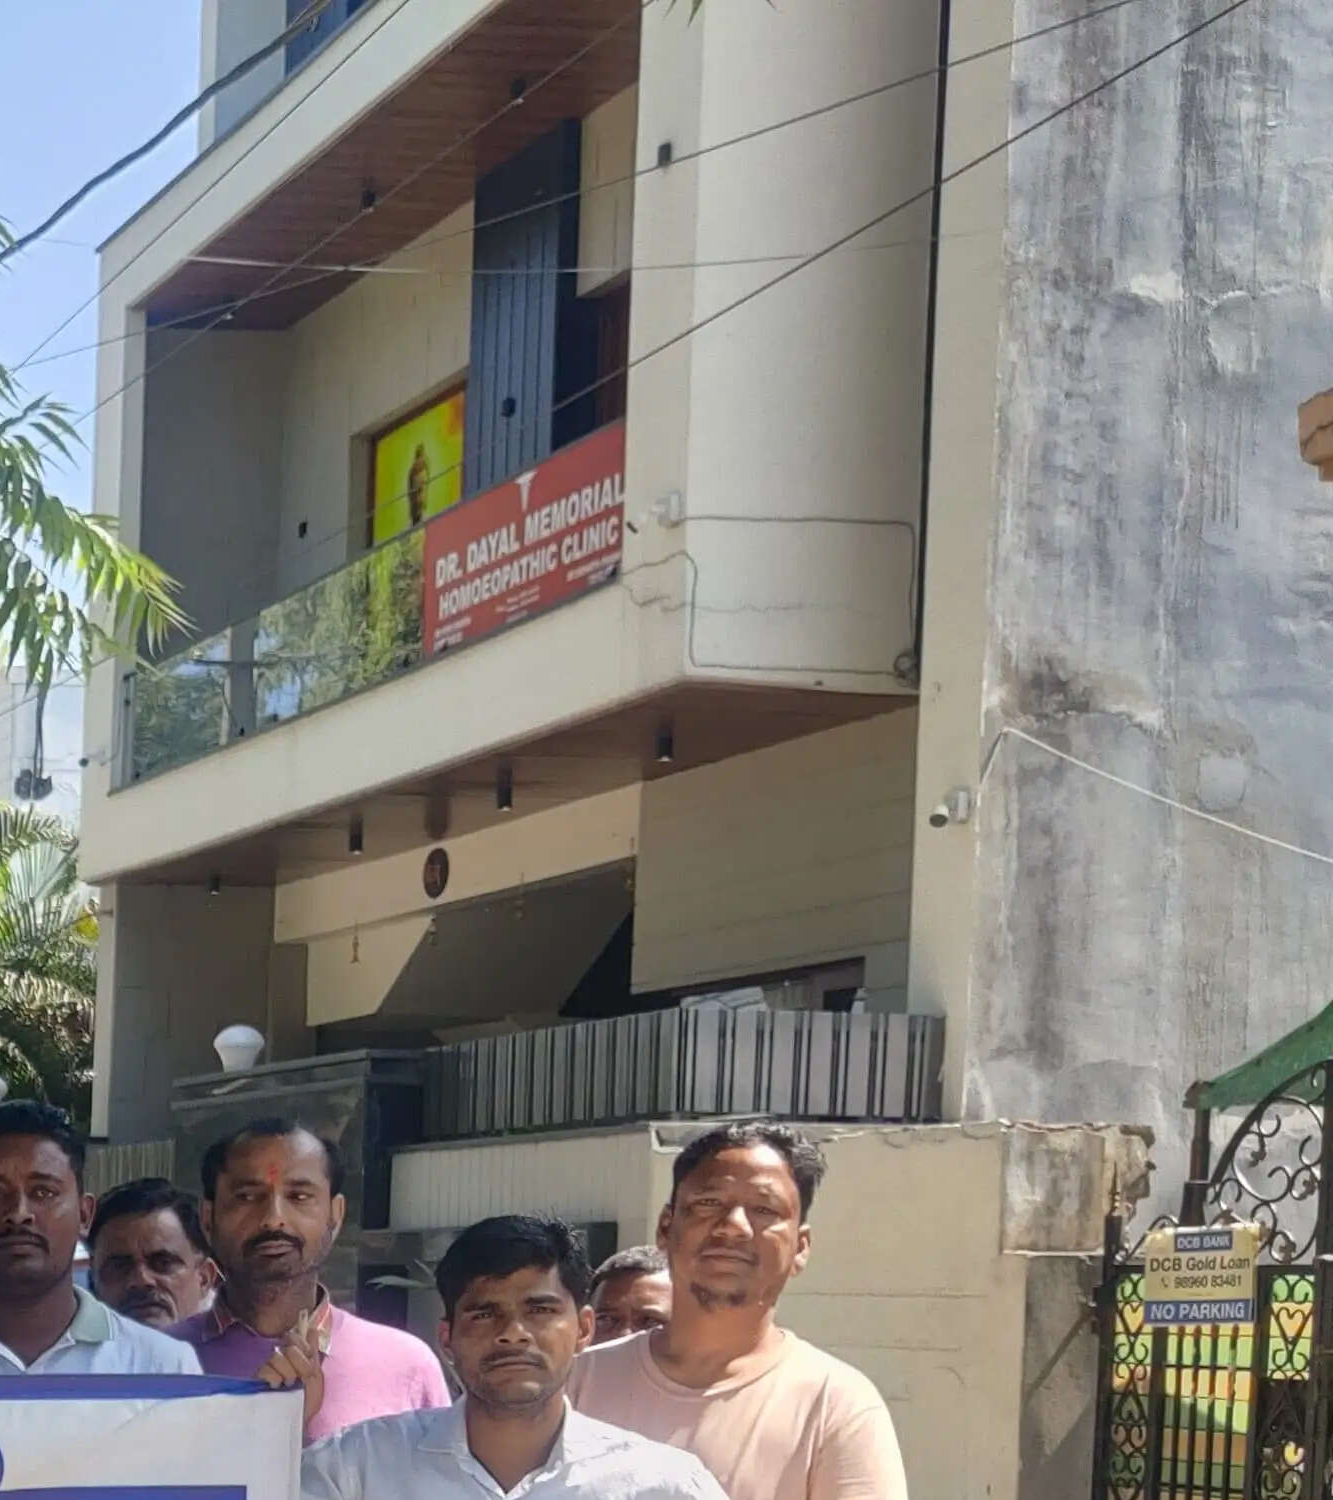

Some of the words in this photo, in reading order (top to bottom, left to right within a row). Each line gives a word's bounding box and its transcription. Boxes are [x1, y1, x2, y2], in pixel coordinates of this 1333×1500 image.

[436, 552, 463, 588] DR.
[467, 523, 520, 570] DAYAL
[524, 473, 625, 541] MEMORIAL
[439, 541, 559, 619] HOMOEOPATHIC
[560, 516, 620, 563] CLINIC
[1177, 1236, 1201, 1249] DCB
[1203, 1234, 1230, 1248] BANK
[1149, 1257, 1182, 1272] DCB
[1186, 1256, 1217, 1271] Gold
[1220, 1255, 1250, 1270] Loan
[1150, 1303, 1175, 1319] NO
[1179, 1301, 1245, 1320] PARKING
